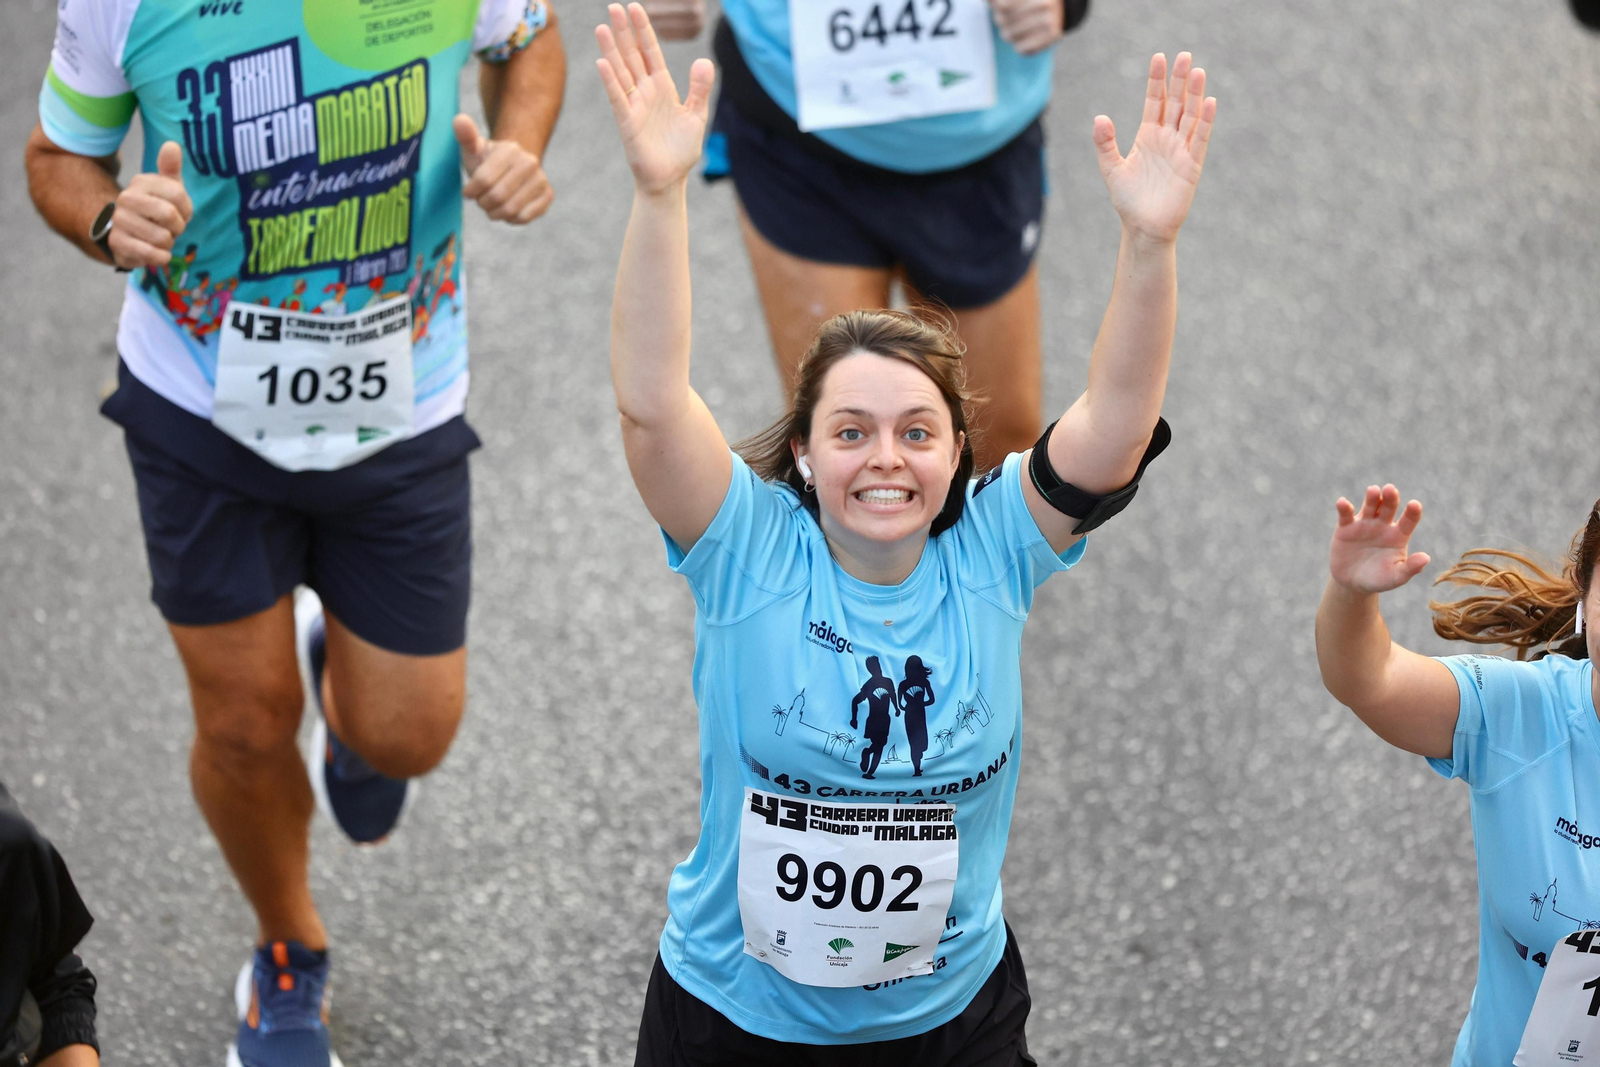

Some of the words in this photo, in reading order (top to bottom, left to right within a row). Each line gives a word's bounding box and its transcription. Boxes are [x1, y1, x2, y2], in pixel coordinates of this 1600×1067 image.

[828, 0, 958, 53] 6442
[233, 101, 317, 175] MEDIA
[315, 63, 427, 165] MARATÓN
[248, 138, 419, 210] internacional
[248, 178, 411, 274] TORREMOLINOS
[231, 310, 282, 342] 43
[258, 360, 388, 406] 1035
[774, 773, 811, 795] 43
[817, 786, 924, 797] CARRERA
[931, 750, 1008, 797] URBANA
[750, 792, 809, 833] 43
[809, 818, 860, 836] CIUDAD
[862, 825, 873, 833] DE
[810, 804, 889, 822] CARRERA
[776, 853, 923, 913] 9902
